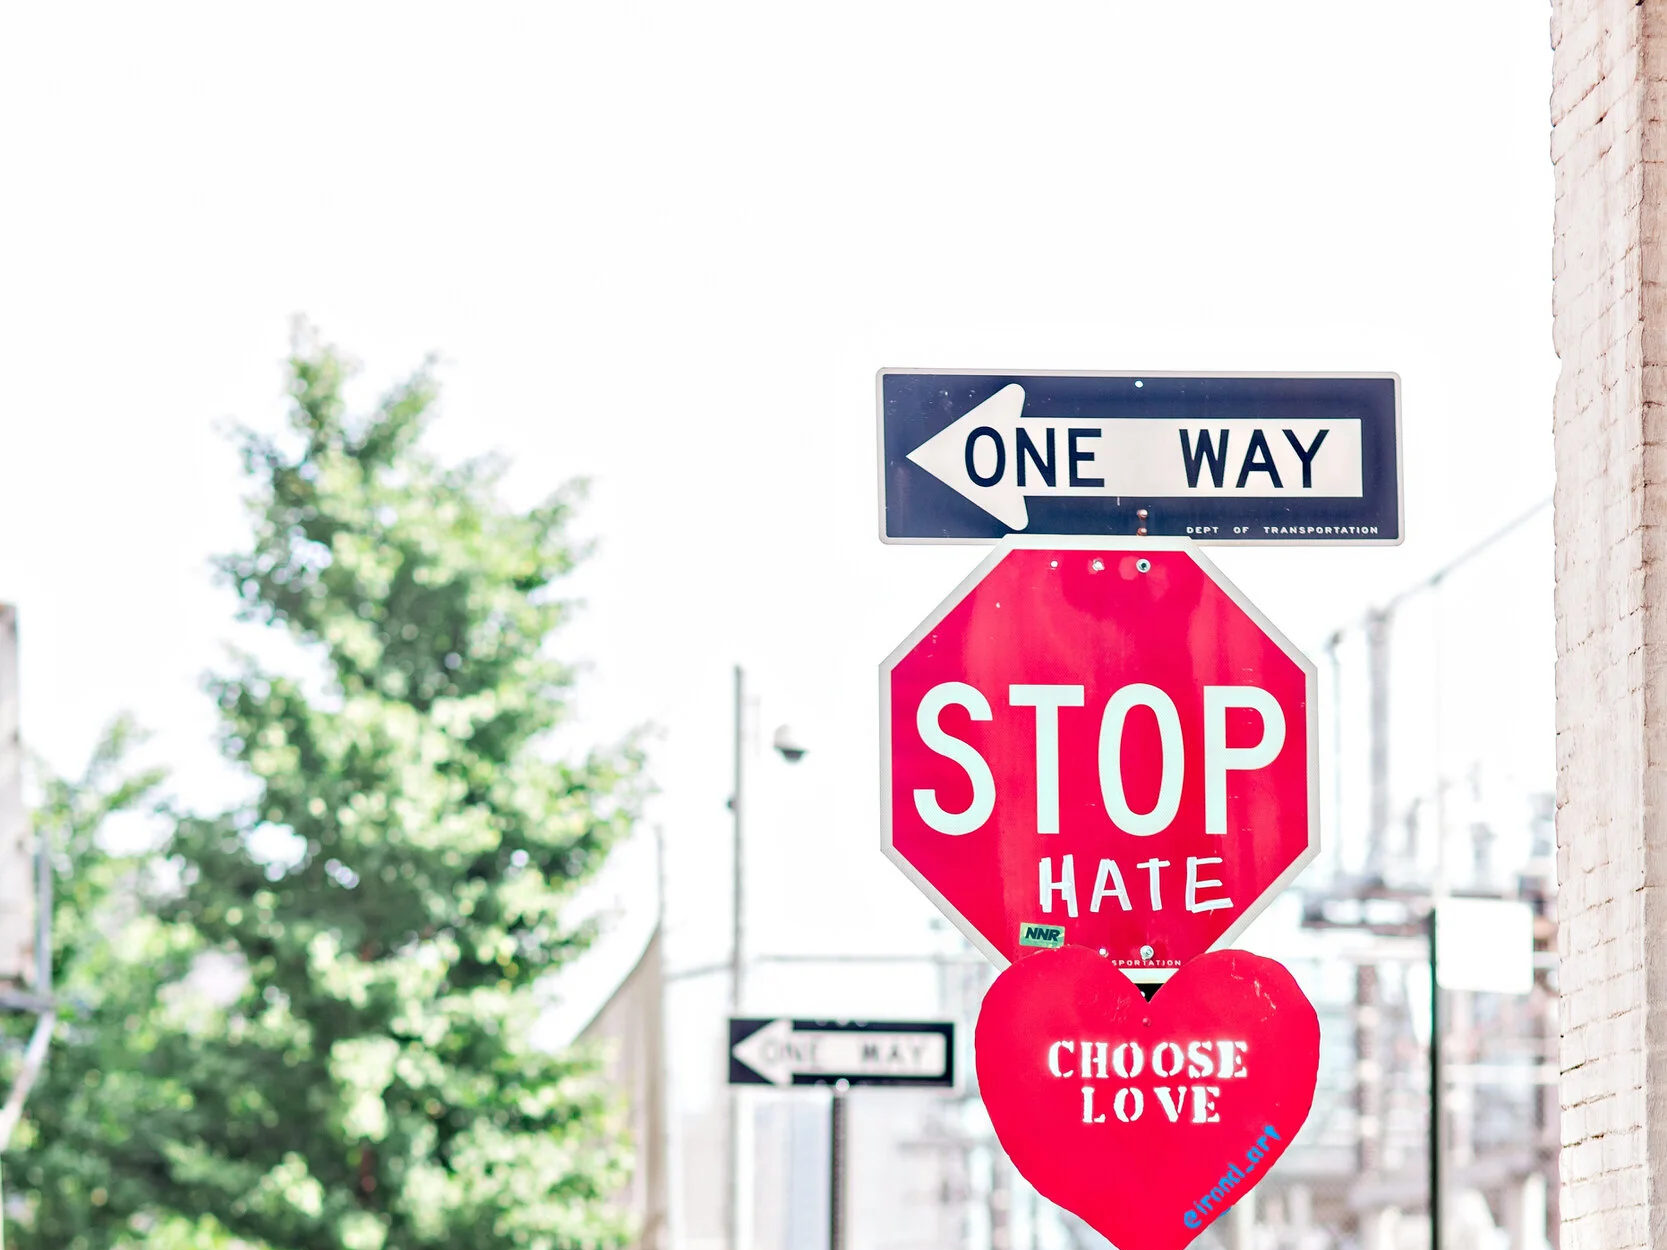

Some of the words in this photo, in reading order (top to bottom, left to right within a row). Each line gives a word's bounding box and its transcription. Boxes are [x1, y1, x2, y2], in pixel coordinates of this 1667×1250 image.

[964, 426, 1105, 488] ONE
[1179, 429, 1330, 489] WAY
[1186, 526, 1220, 534] DEPT
[1233, 526, 1249, 534] OF
[1263, 526, 1379, 535] TRANSPORTATION
[913, 681, 1287, 836] STOP
[1039, 854, 1234, 917] HATE
[1025, 927, 1061, 942] NNR
[759, 1037, 823, 1069] ONE
[861, 1038, 927, 1070] WAY
[1048, 1040, 1248, 1079] CHOOSE
[1081, 1085, 1221, 1124] LOVE
